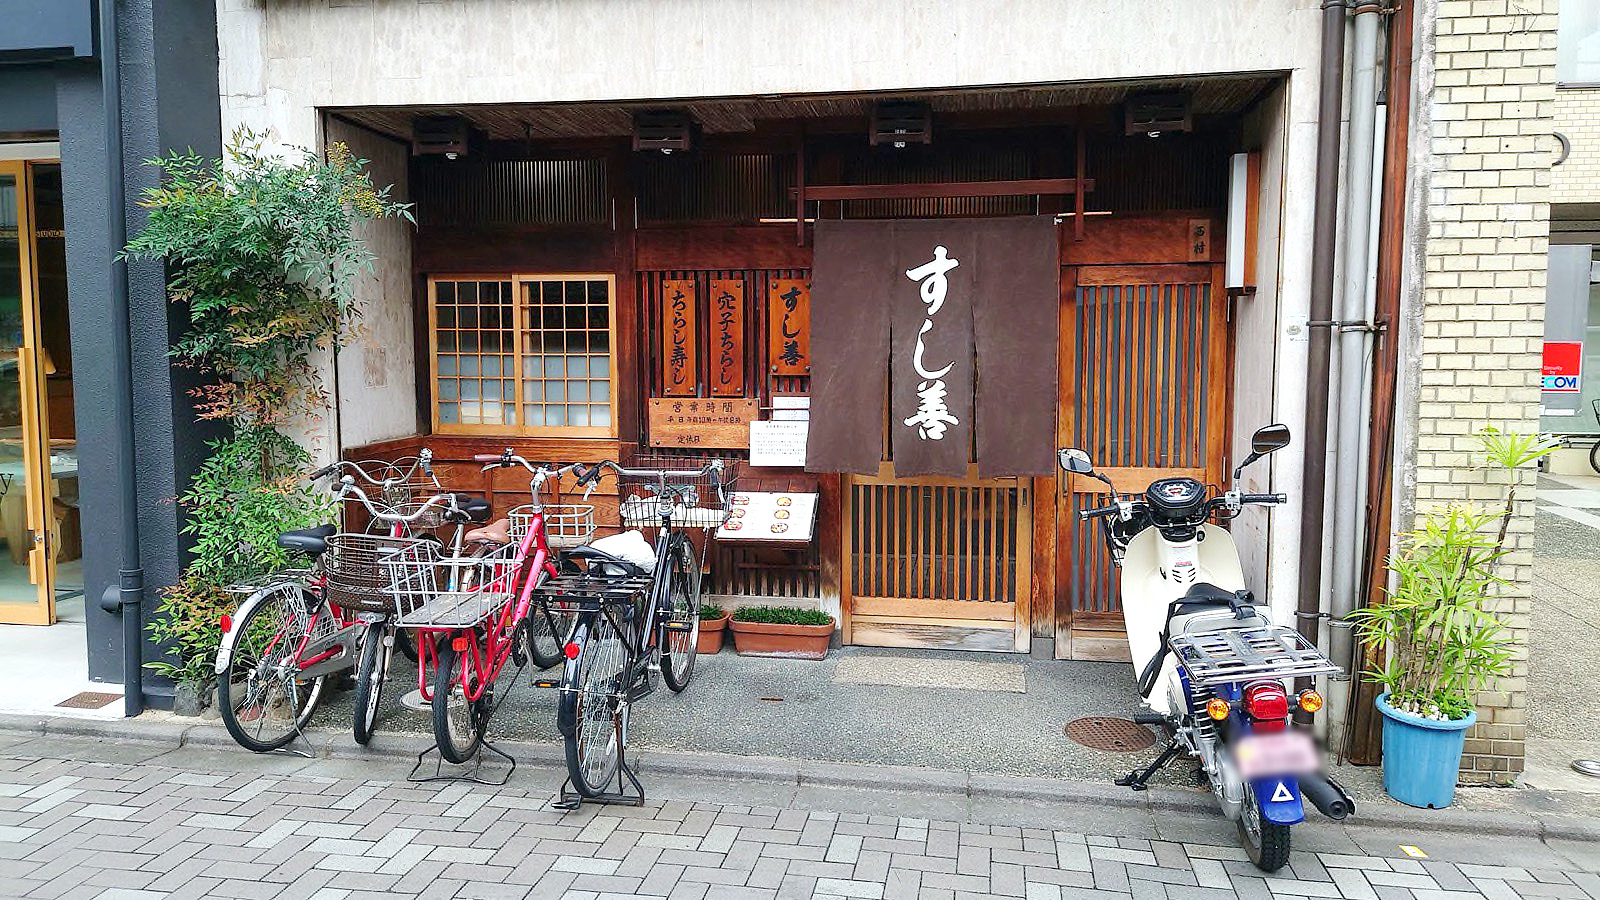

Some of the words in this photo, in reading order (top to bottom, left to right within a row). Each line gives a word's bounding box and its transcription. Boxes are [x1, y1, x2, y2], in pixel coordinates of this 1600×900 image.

[671, 290, 688, 385] ちらし寿し
[717, 291, 736, 385] 穴子ちらし
[779, 287, 804, 366] すし善
[904, 245, 959, 440] すし善
[673, 401, 733, 413] 営業時間
[677, 435, 700, 444] 定休日
